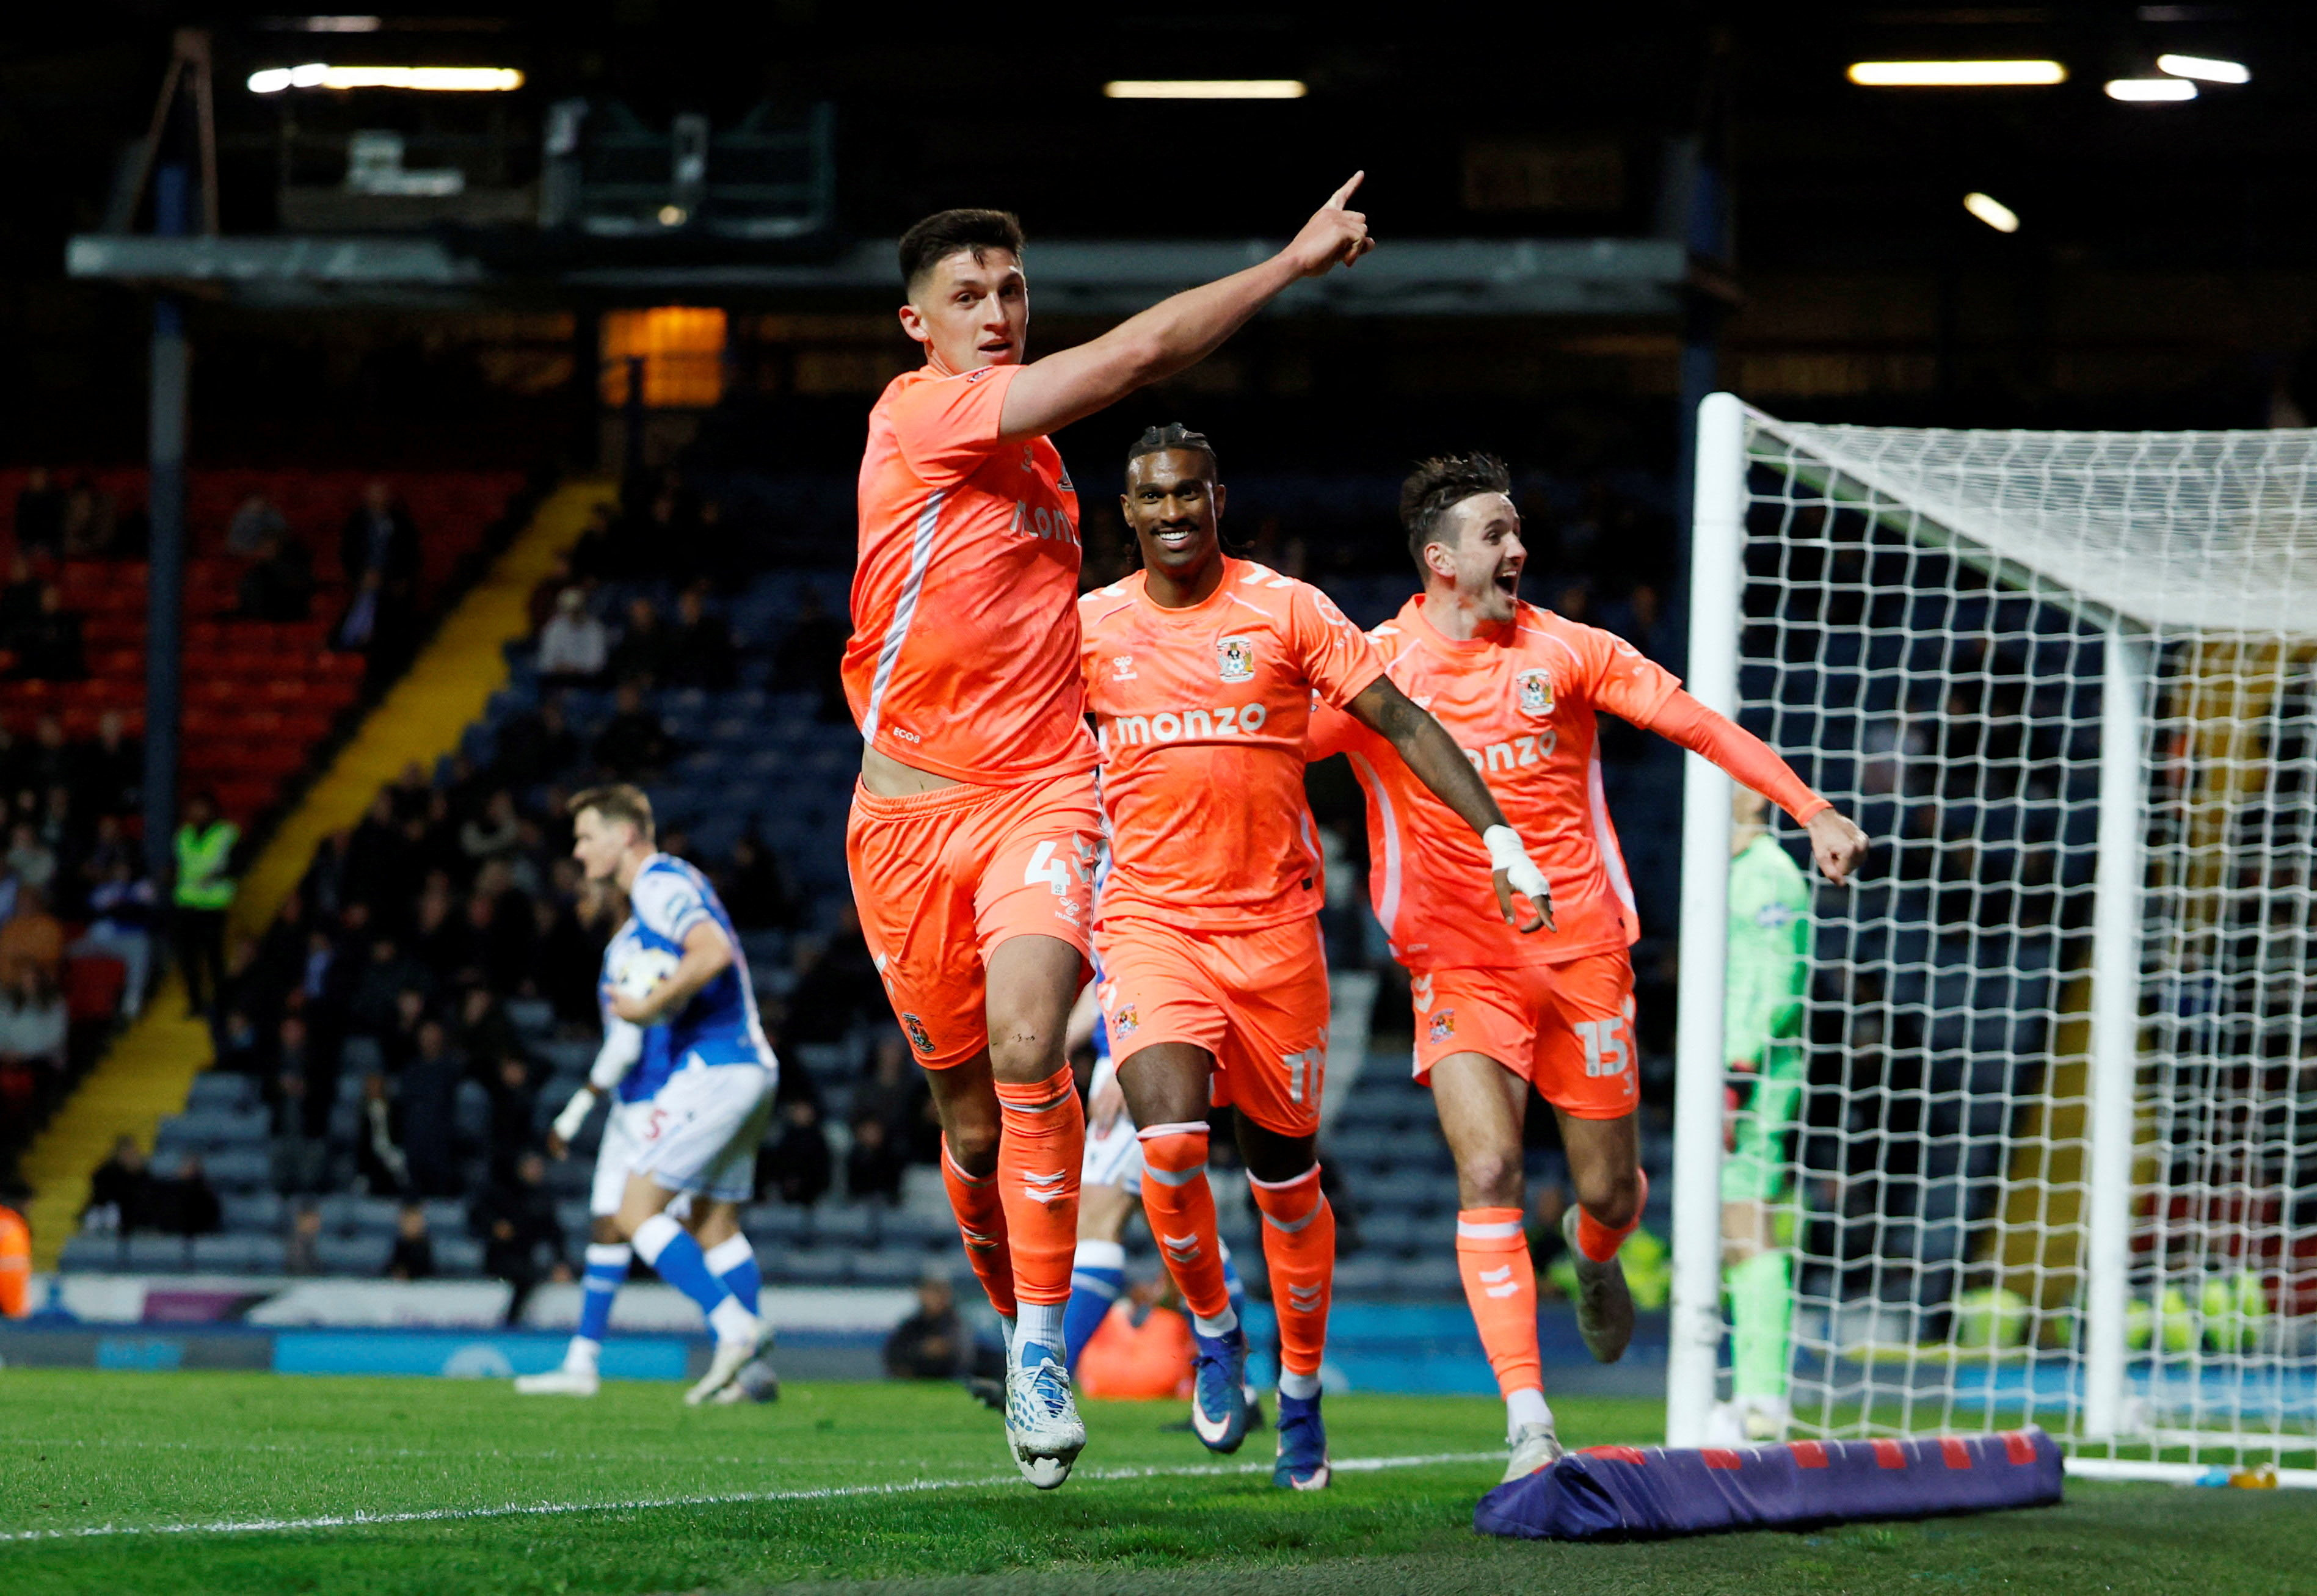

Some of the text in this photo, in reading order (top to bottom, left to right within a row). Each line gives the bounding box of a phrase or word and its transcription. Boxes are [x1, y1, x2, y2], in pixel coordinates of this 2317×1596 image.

[893, 727, 920, 743] ECO8
[1116, 703, 1267, 744] monzo
[1463, 730, 1557, 772] onzo
[1024, 841, 1071, 896] 4
[1574, 1017, 1628, 1077] 15
[1283, 1048, 1318, 1103] 11
[646, 1109, 667, 1141] 5
